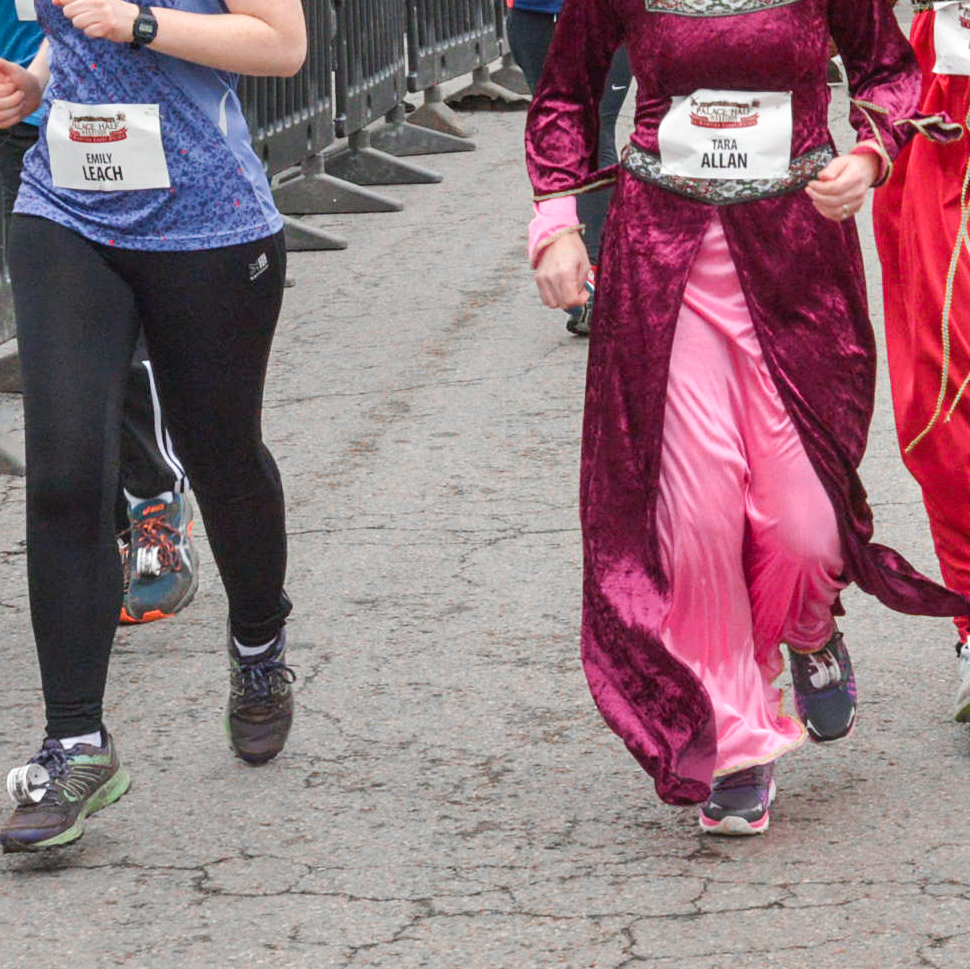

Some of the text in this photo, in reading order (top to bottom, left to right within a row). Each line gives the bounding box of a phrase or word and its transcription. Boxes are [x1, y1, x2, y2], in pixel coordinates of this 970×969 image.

[711, 139, 738, 150] TARA
[86, 153, 112, 164] EMILY
[700, 153, 748, 168] ALLAN
[82, 165, 124, 181] LEACH
